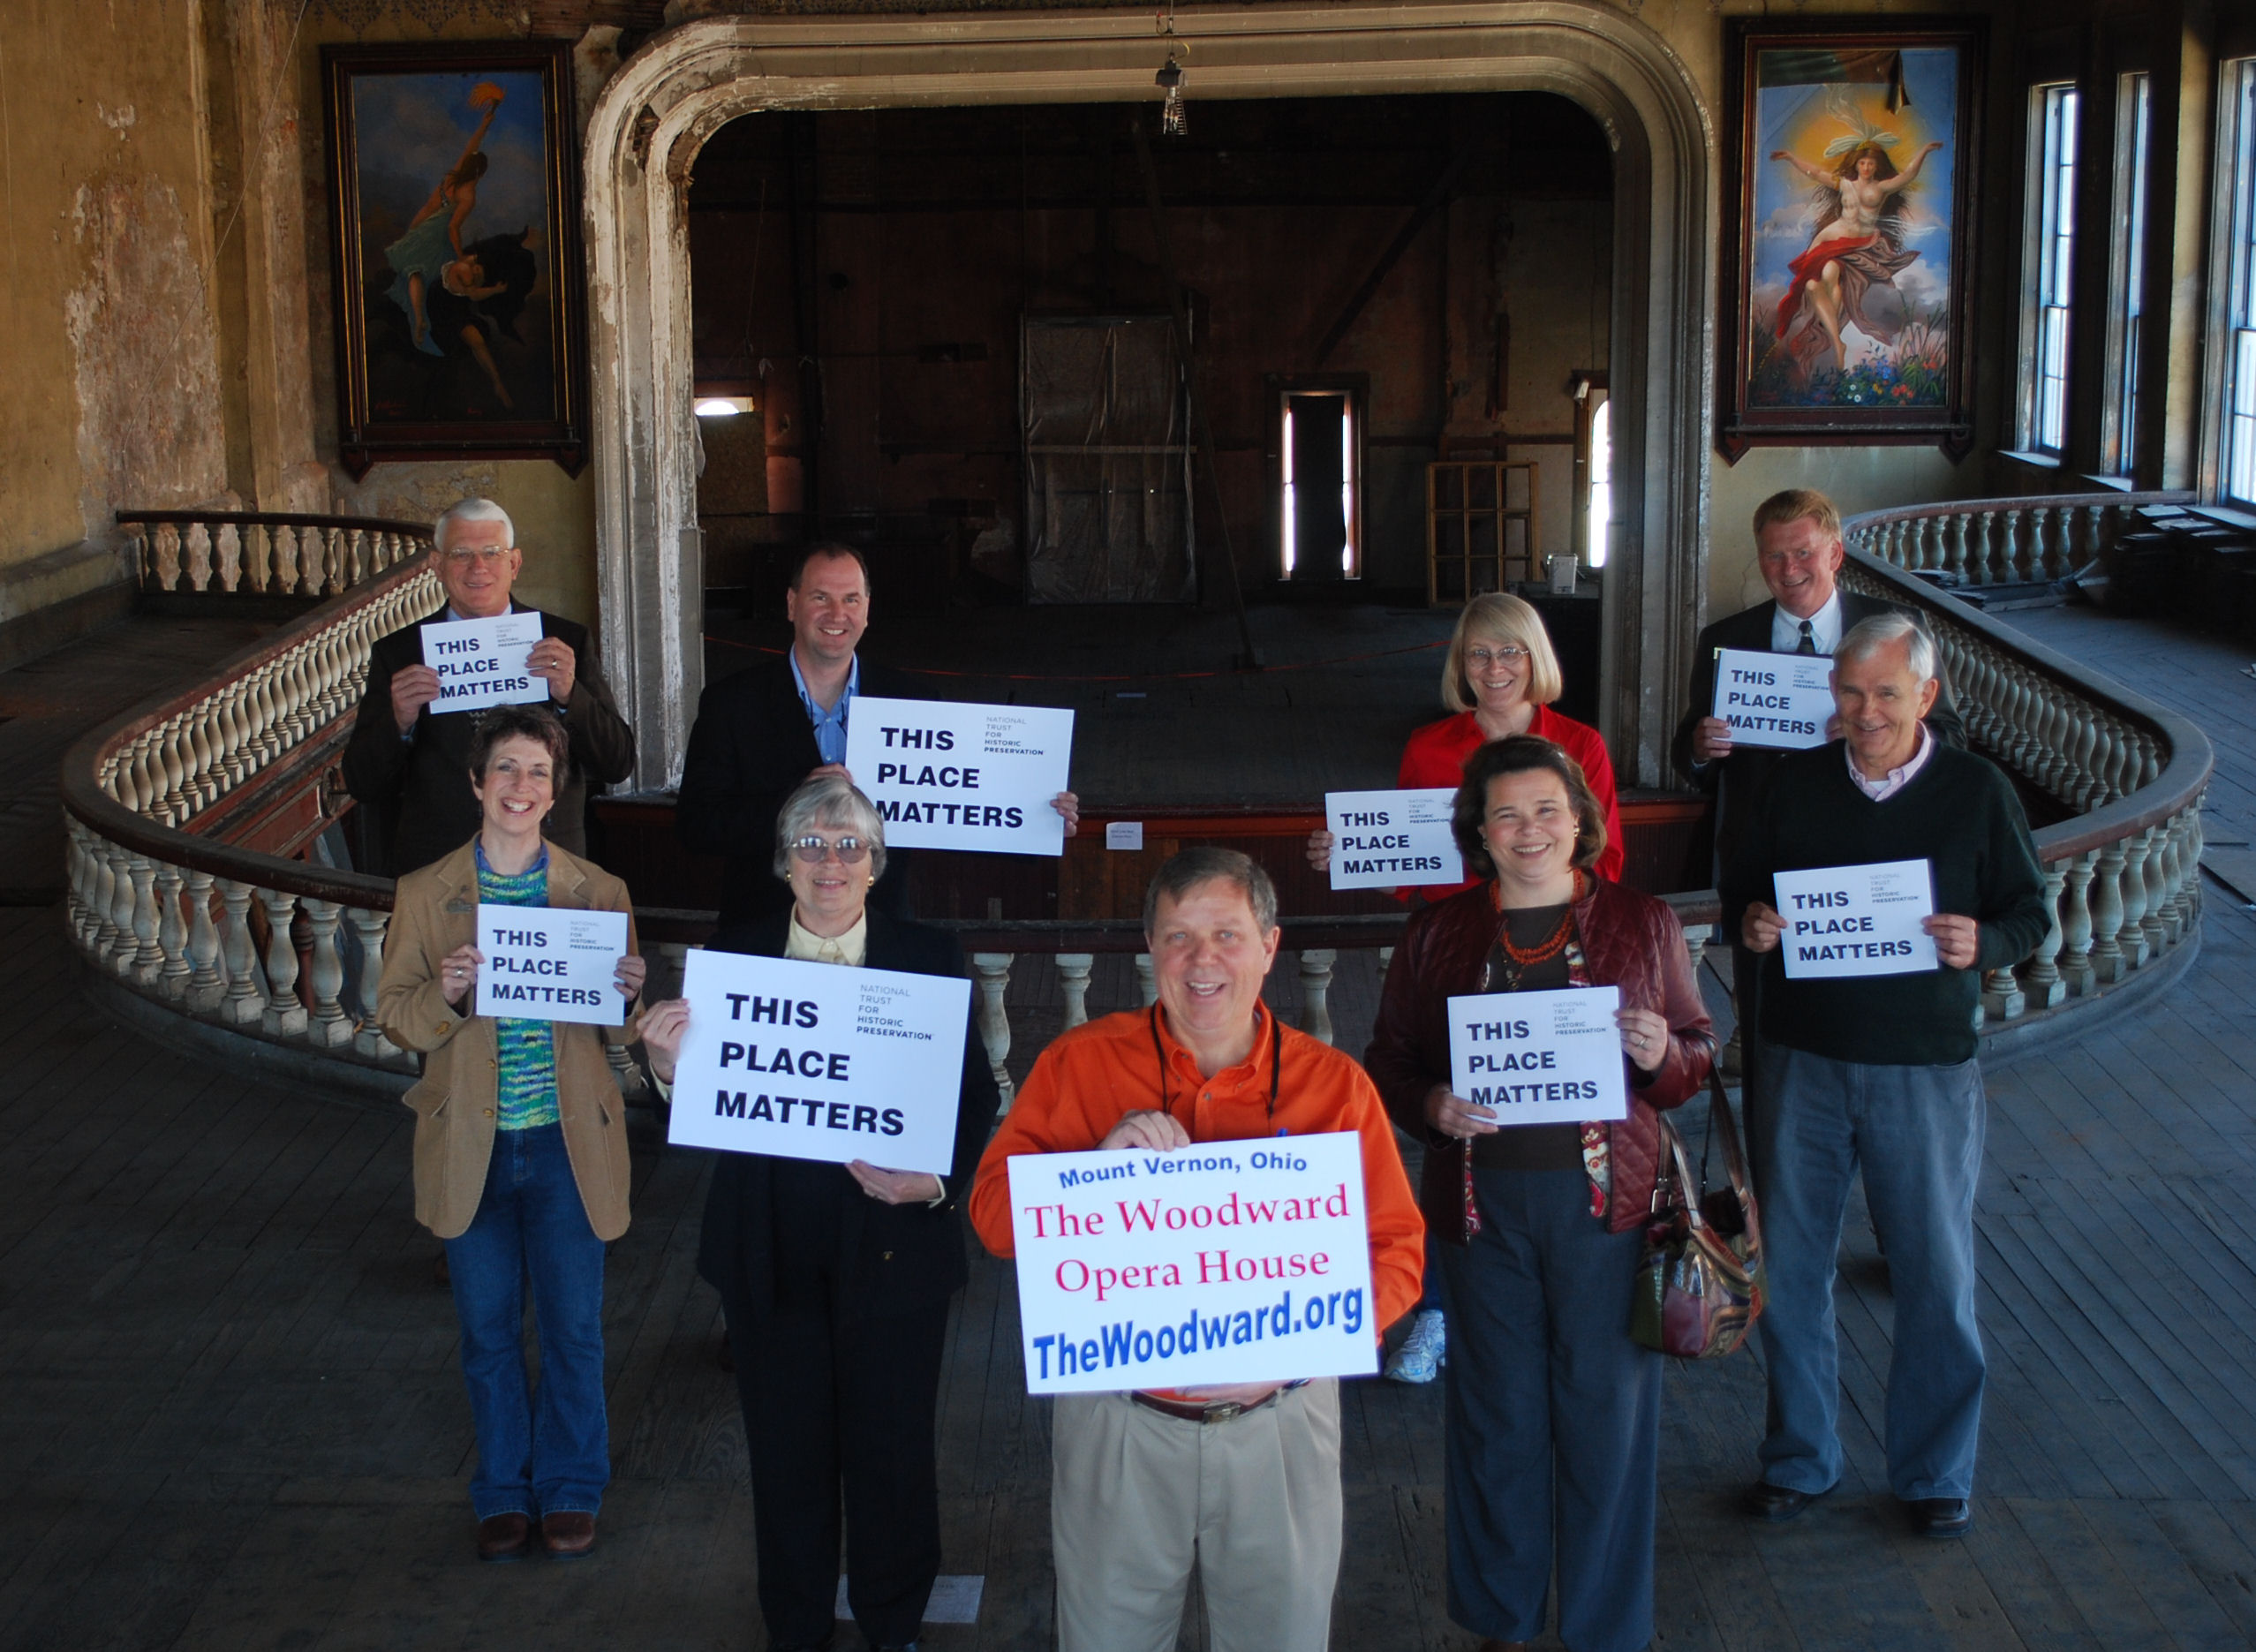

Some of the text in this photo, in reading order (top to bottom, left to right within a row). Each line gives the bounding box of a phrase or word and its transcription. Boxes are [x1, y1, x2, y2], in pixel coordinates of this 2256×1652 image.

[435, 638, 480, 655] THIS
[438, 659, 500, 677] PLACE
[1731, 669, 1775, 686] THIS
[440, 677, 529, 698] MATTERS
[1728, 692, 1791, 710] PLACE
[986, 716, 1027, 725] NATIONAL
[1726, 714, 1815, 735] MATTERS
[880, 727, 954, 751] THIS
[984, 746, 1044, 755] PRESERVATION
[877, 763, 980, 788] PLACE
[876, 800, 1023, 828] MATTERS
[1339, 811, 1390, 827] THIS
[1342, 834, 1410, 850] PLACE
[1343, 856, 1442, 874] MATTERS
[1791, 891, 1849, 909] THIS
[1794, 917, 1874, 936] PLACE
[493, 929, 547, 947] THIS
[1798, 940, 1913, 962] MATTERS
[493, 956, 568, 977] PLACE
[492, 983, 601, 1006] MATTERS
[860, 984, 911, 997] NATIONAL
[860, 994, 892, 1005] TRUST
[725, 992, 819, 1030] THIS
[858, 1005, 879, 1015] FOR
[857, 1015, 904, 1028] HISTORIC
[1466, 1020, 1530, 1042] THIS
[1555, 1027, 1607, 1036] PRESERVATION
[856, 1025, 932, 1041] PRESERVATION
[719, 1041, 850, 1082] PLACE
[1468, 1051, 1556, 1074] PLACE
[1470, 1081, 1598, 1105] MATTERS
[714, 1089, 905, 1136] MATTERS
[1058, 1151, 1308, 1189] Mount Vernon, Ohio
[1024, 1182, 1351, 1239] The Woodward
[1054, 1248, 1331, 1302] Opera House
[1032, 1286, 1363, 1380] TheWoodward.org
